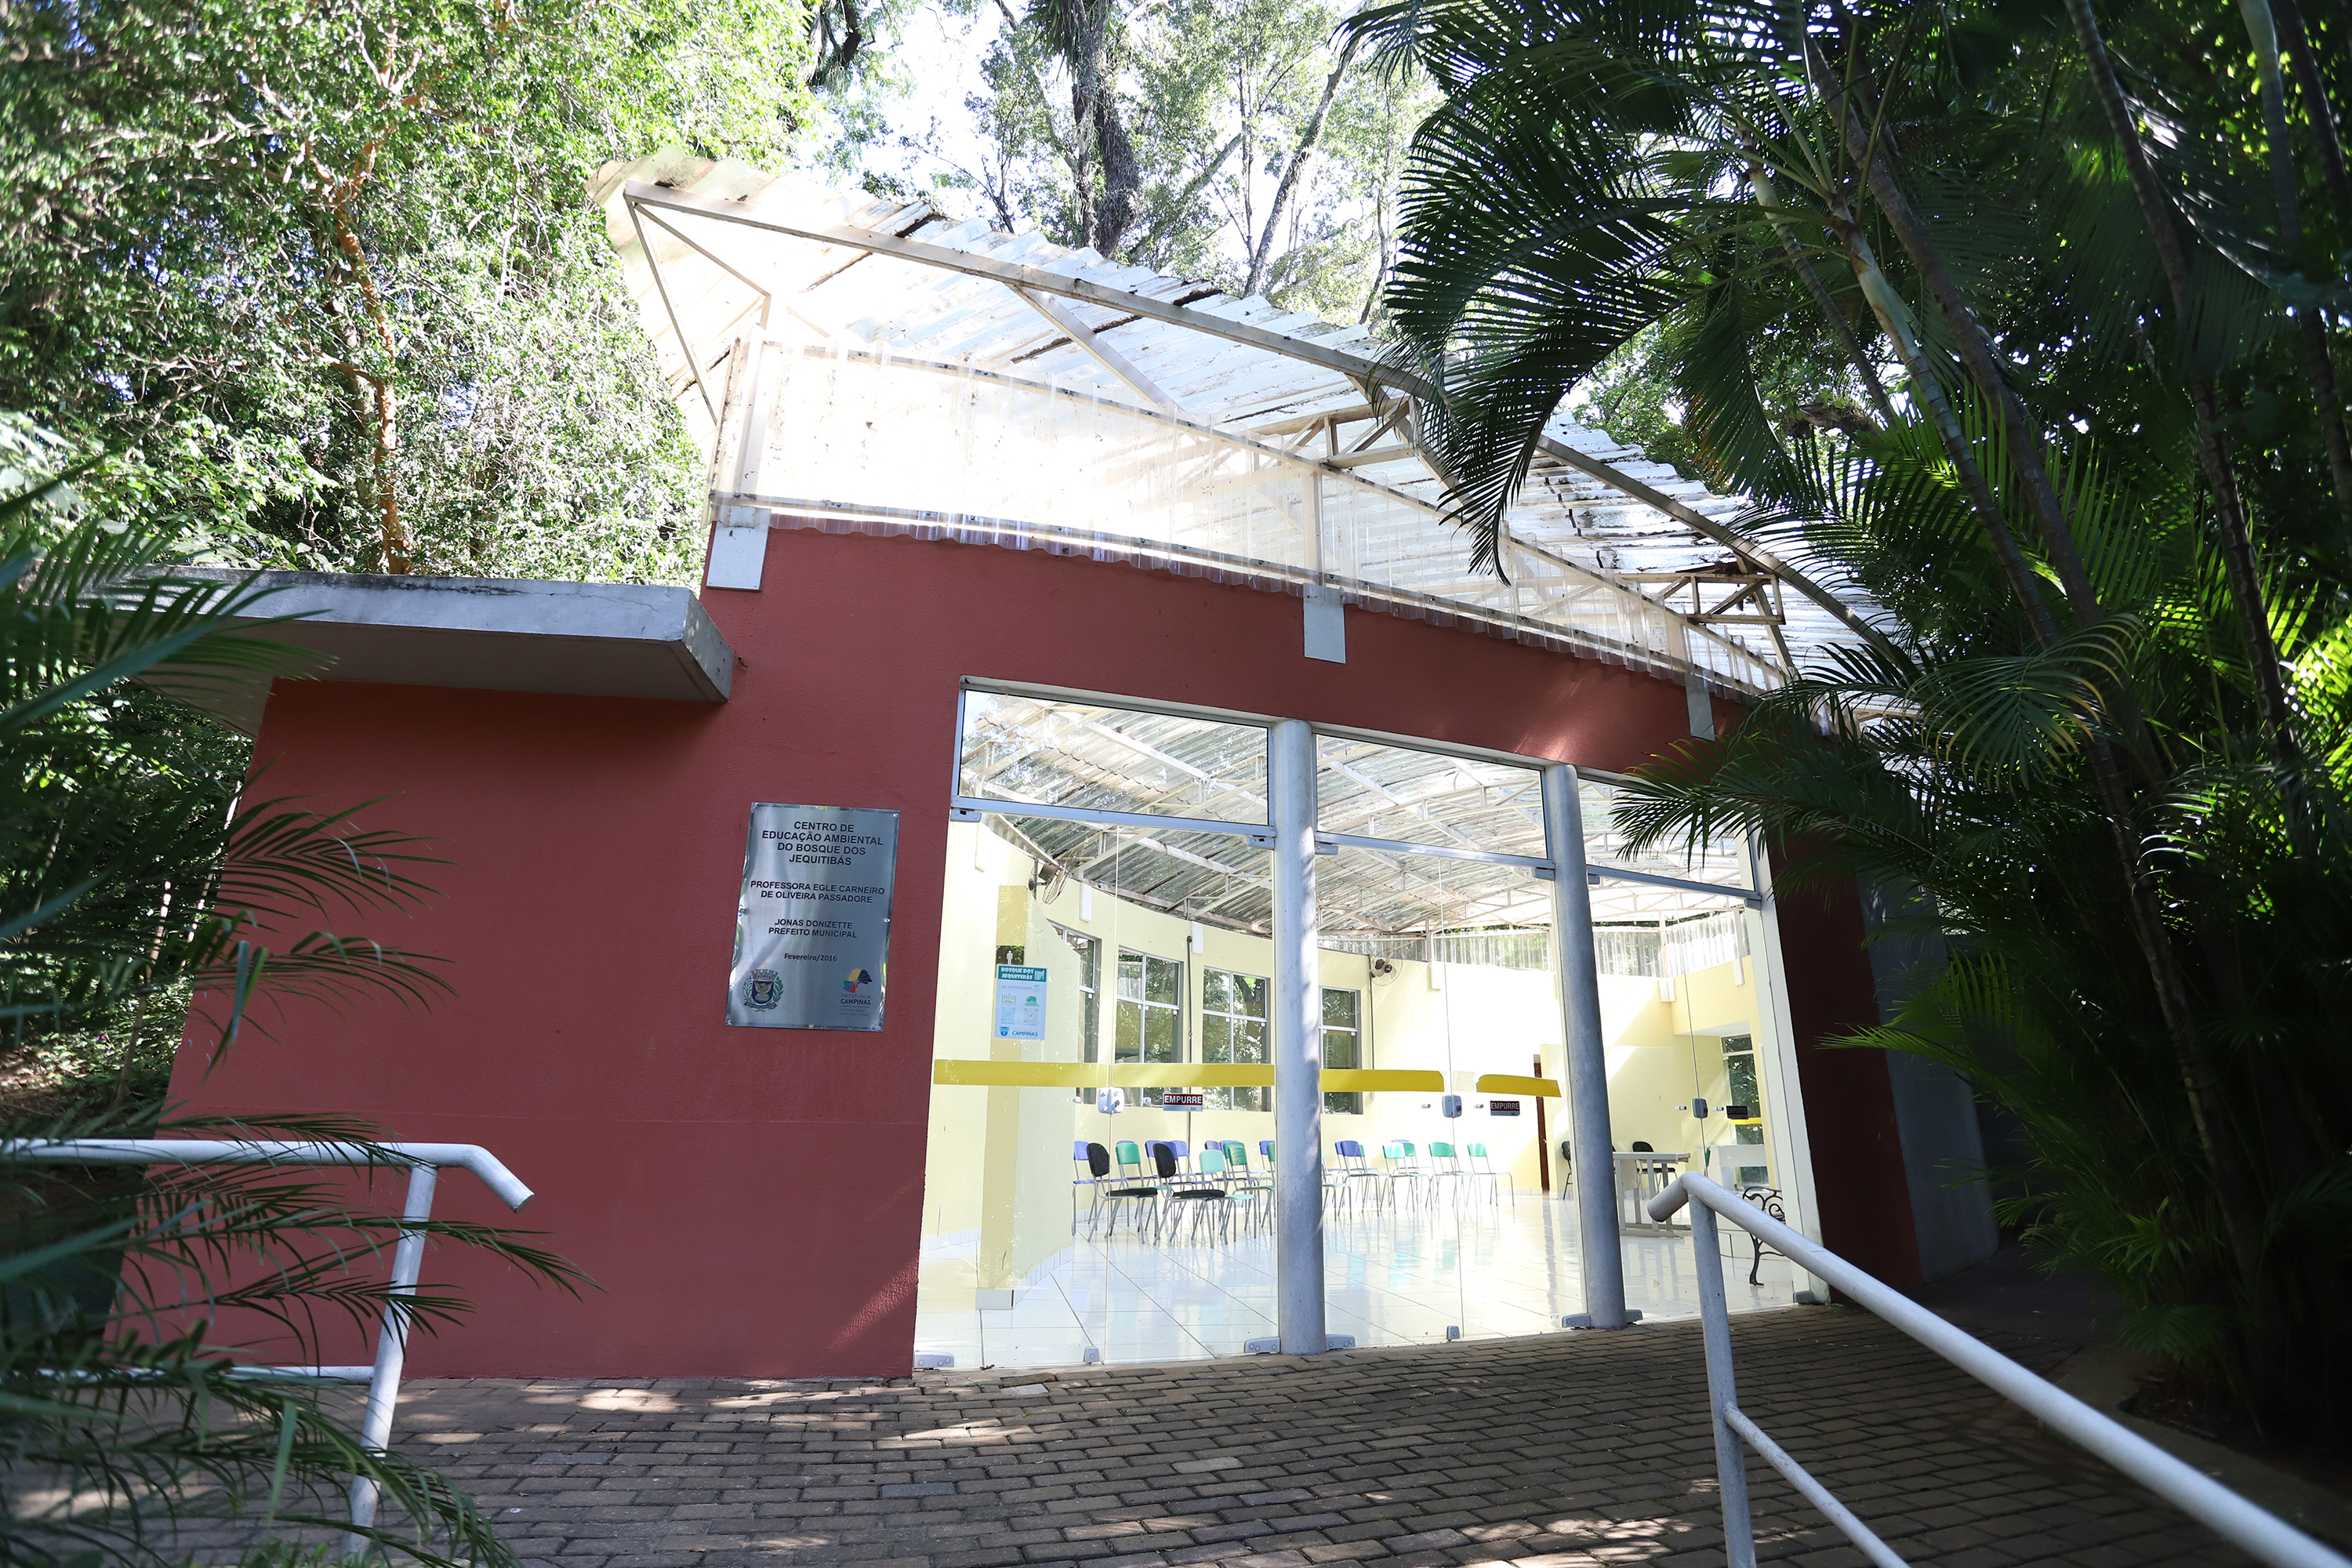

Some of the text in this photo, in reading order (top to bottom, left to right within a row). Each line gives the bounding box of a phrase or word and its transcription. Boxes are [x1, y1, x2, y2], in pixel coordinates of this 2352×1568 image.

[794, 821, 855, 833] CENTRO DE
[762, 830, 884, 846] EDUCAÇÃO AMBIENTAL
[777, 843, 866, 855] DO BOSQUE DOS
[789, 854, 852, 866] JEQUITIBÁS
[750, 880, 885, 895] PROFESSORA EGLE CARNEIRO
[775, 891, 816, 900] OLIVEIRA
[818, 894, 873, 903] PASSADORE
[806, 920, 853, 929] DONIZETTE
[768, 927, 858, 938] PREFEITO MUNICIPAL
[784, 953, 837, 962] Fevereiro/2016
[1164, 1094, 1202, 1104] EMPURRE
